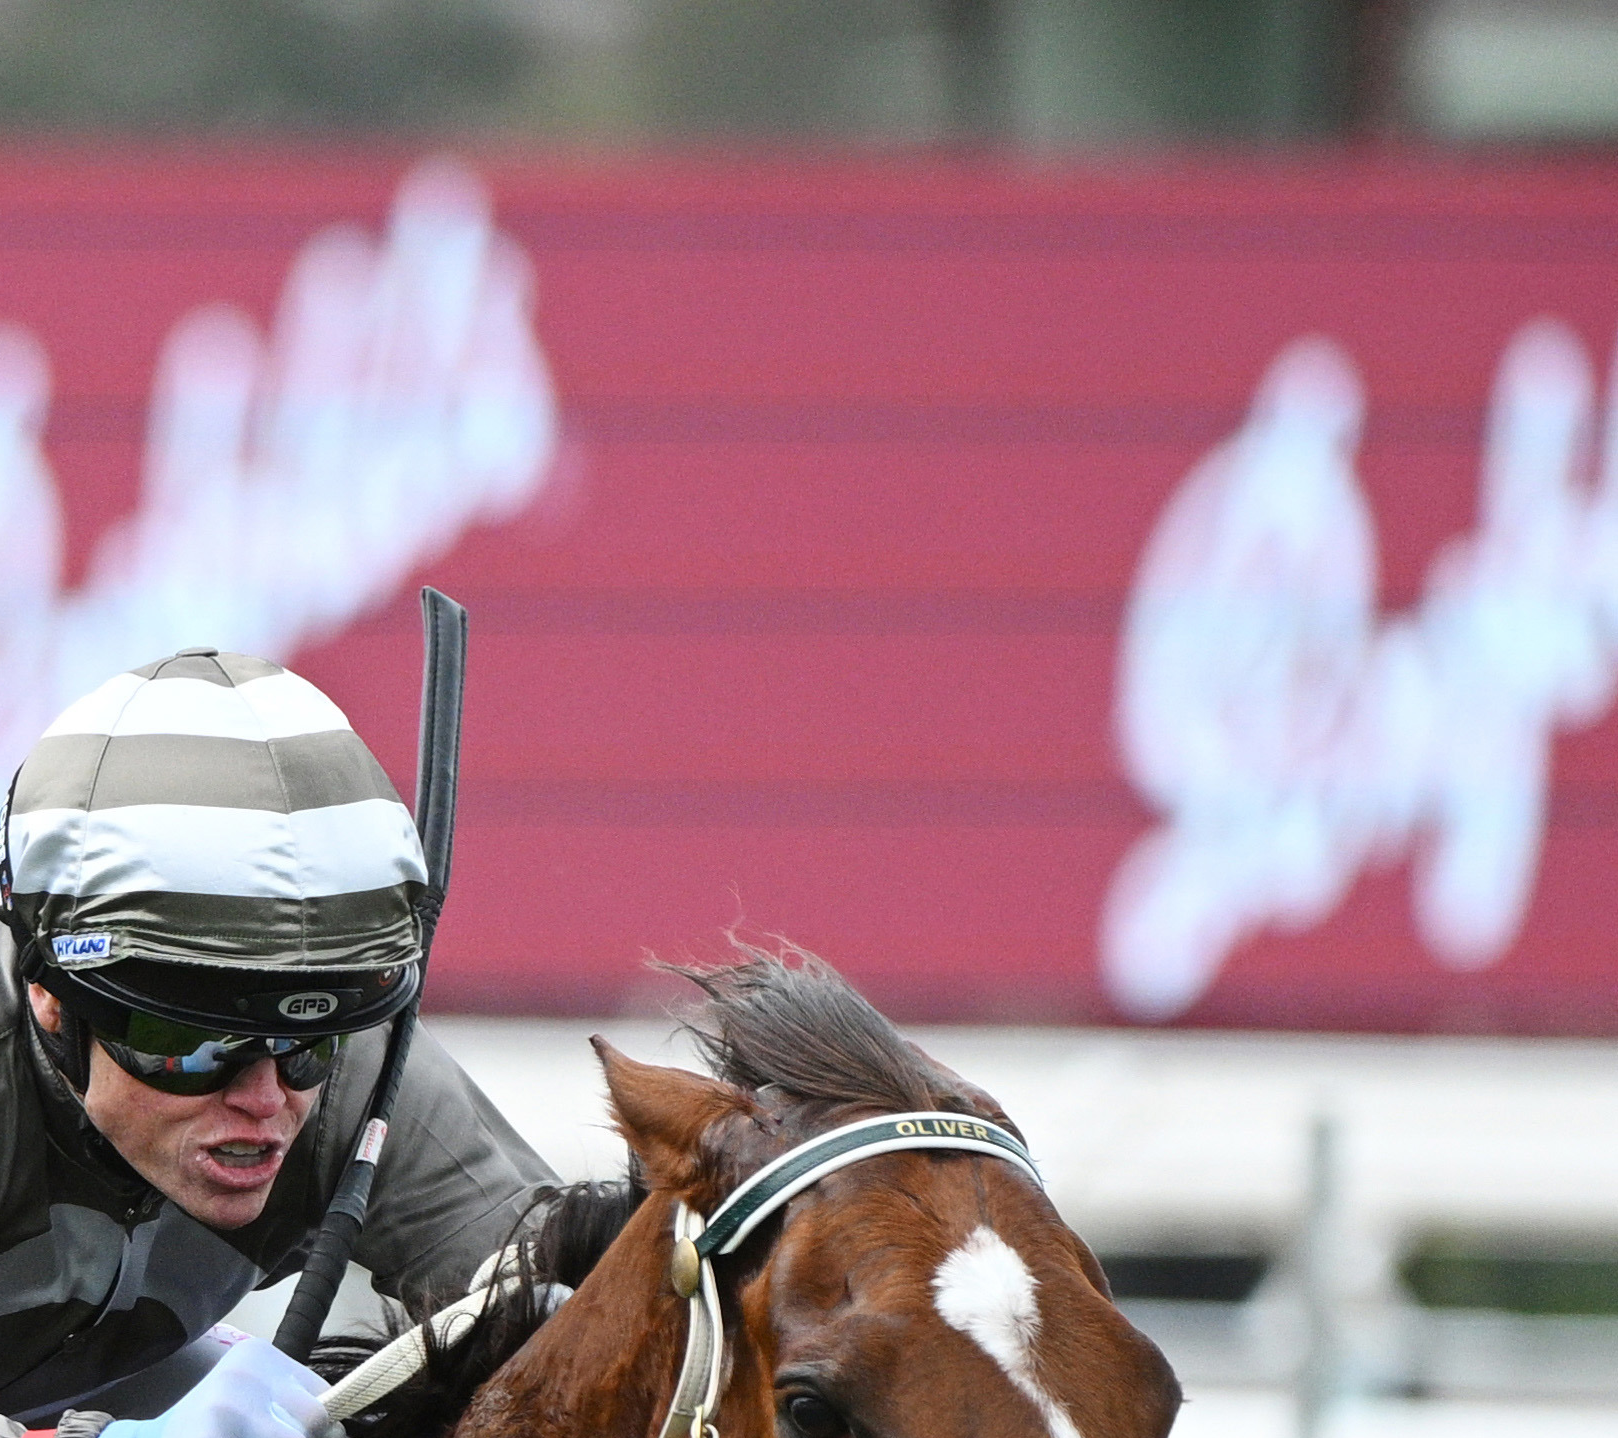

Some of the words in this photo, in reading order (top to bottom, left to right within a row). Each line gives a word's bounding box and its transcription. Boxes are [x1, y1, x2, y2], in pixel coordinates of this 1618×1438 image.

[57, 936, 107, 957] HYLAND
[285, 998, 333, 1015] GPA
[896, 1119, 990, 1141] OLIVER
